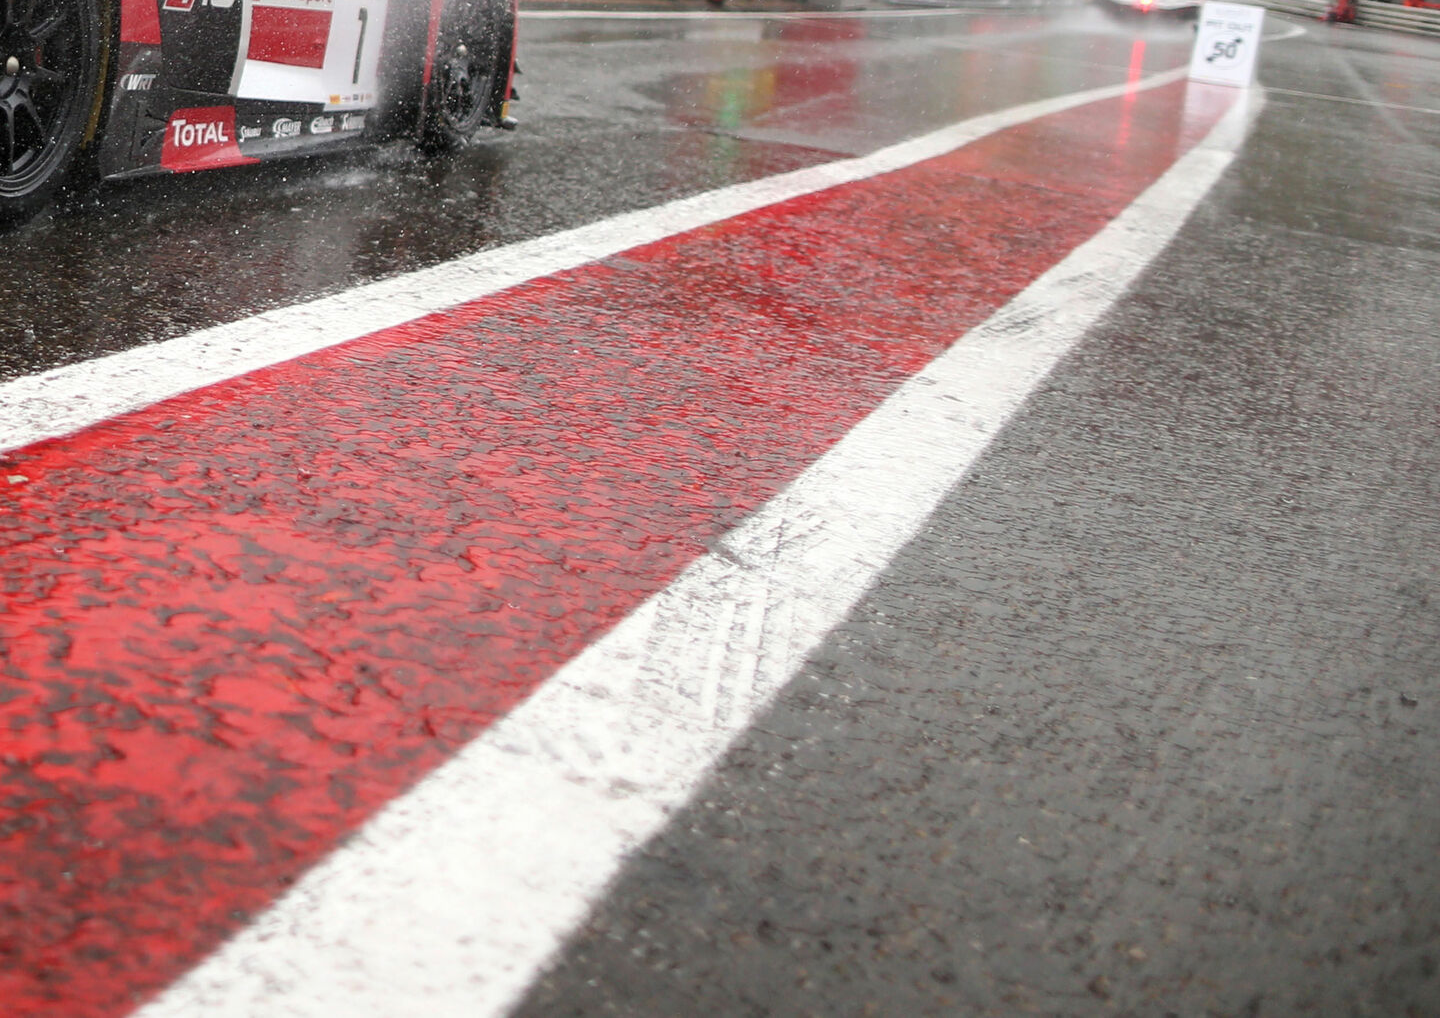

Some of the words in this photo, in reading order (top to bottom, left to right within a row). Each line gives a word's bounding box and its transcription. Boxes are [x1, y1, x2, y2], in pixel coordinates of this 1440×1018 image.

[352, 7, 369, 85] 1
[1213, 41, 1238, 59] 50
[124, 73, 157, 91] WRT
[172, 119, 229, 147] TOTAL
